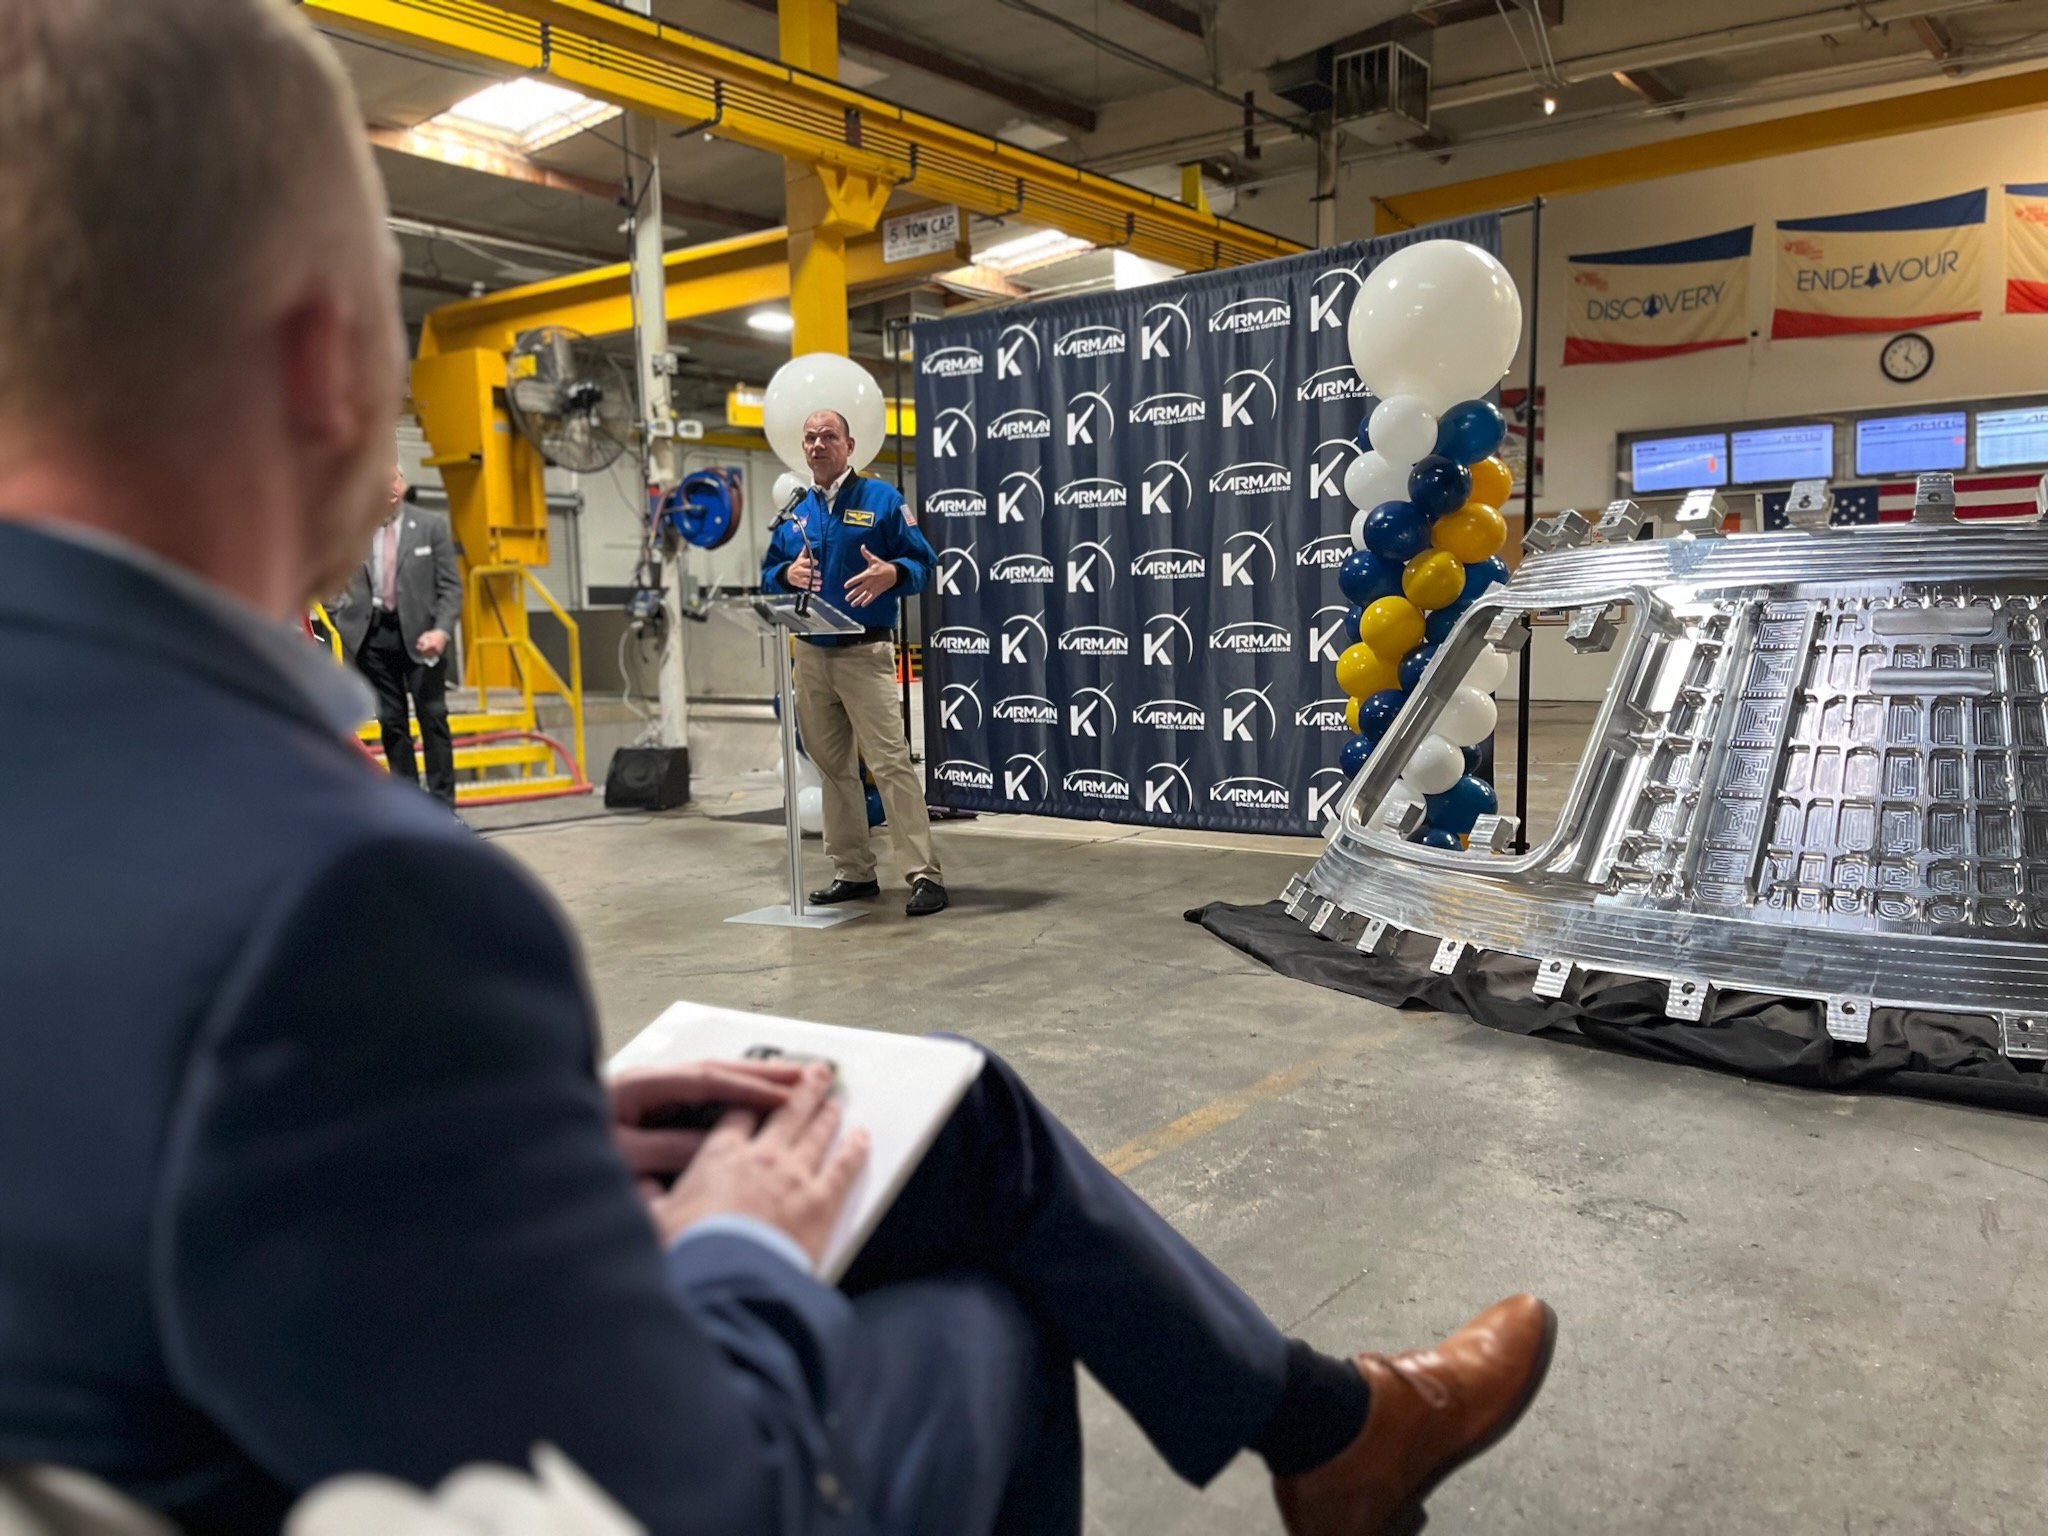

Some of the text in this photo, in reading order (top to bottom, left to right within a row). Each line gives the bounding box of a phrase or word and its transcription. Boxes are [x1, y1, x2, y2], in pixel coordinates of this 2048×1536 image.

[905, 221, 928, 239] TON
[1310, 281, 1345, 332] K
[1587, 280, 1726, 321] DISCOVERY
[1209, 305, 1290, 332] KARMAN
[1235, 326, 1254, 334] SPACE
[1261, 320, 1291, 330] DEFENSE
[1054, 333, 1125, 356] KARMAN
[1141, 315, 1171, 360] K
[922, 355, 983, 374] KARMAN
[998, 336, 1024, 380] K
[1297, 378, 1369, 401] KARMA
[1323, 394, 1345, 402] SPACE
[1129, 401, 1205, 423] KARMAN
[1222, 381, 1256, 428] K
[987, 418, 1050, 439] KARMAN
[1067, 403, 1095, 446] K
[1177, 415, 1205, 423] DEFENSE
[933, 418, 959, 458] K
[1209, 471, 1291, 492] KARMAN
[1310, 451, 1345, 499] K
[926, 496, 986, 512] KARMAN
[998, 483, 1027, 524] K
[1054, 487, 1126, 505] KARMAN
[1142, 472, 1173, 515] K
[1131, 557, 1205, 576] KARMAN
[1222, 544, 1256, 587] K
[1296, 546, 1352, 566] KARM
[936, 558, 962, 595] K
[990, 563, 1053, 581] KARMAN
[1067, 553, 1096, 593] K
[930, 633, 989, 649] KARMAN
[1001, 625, 1029, 664] K
[1058, 633, 1128, 650] KARMAN
[1143, 626, 1175, 666] K
[1210, 630, 1291, 648] KARMAN
[1309, 618, 1344, 662] K
[940, 694, 965, 730] K
[993, 702, 1058, 720] KARMAN
[1070, 699, 1099, 737] K
[1133, 706, 1204, 725] KARMAN
[1223, 700, 1257, 741] K
[1295, 707, 1347, 726] KARM
[934, 765, 993, 784] KARMAN
[1004, 765, 1032, 801] K
[1063, 775, 1129, 795] KARMAN
[1145, 775, 1175, 814] K
[1210, 783, 1289, 803] KARMAN
[1308, 781, 1342, 822] K
